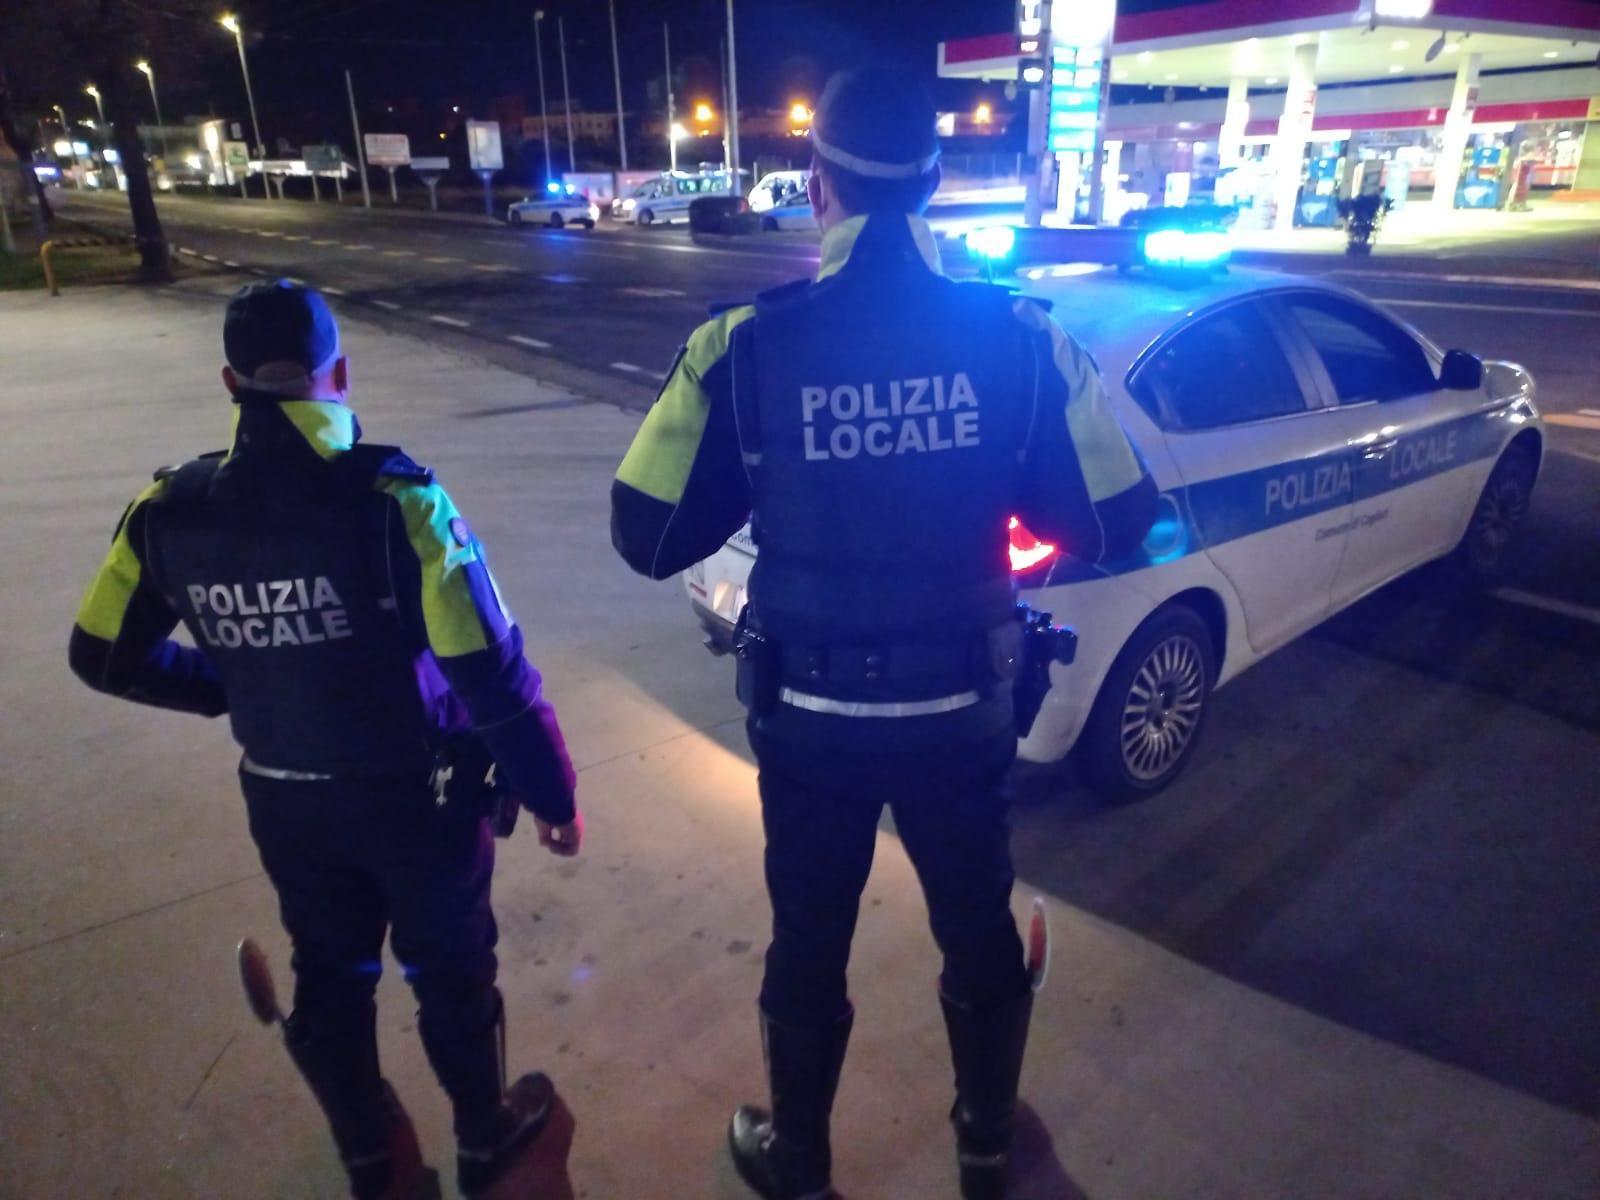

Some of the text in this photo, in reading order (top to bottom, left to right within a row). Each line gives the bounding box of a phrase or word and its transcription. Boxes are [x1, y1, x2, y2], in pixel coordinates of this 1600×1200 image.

[802, 373, 978, 422] POLIZIA
[804, 413, 980, 460] LOCALE
[1266, 431, 1456, 514] POLIZIA LOCALE
[188, 577, 342, 615] POLIZIA
[199, 610, 352, 647] LOCALE
